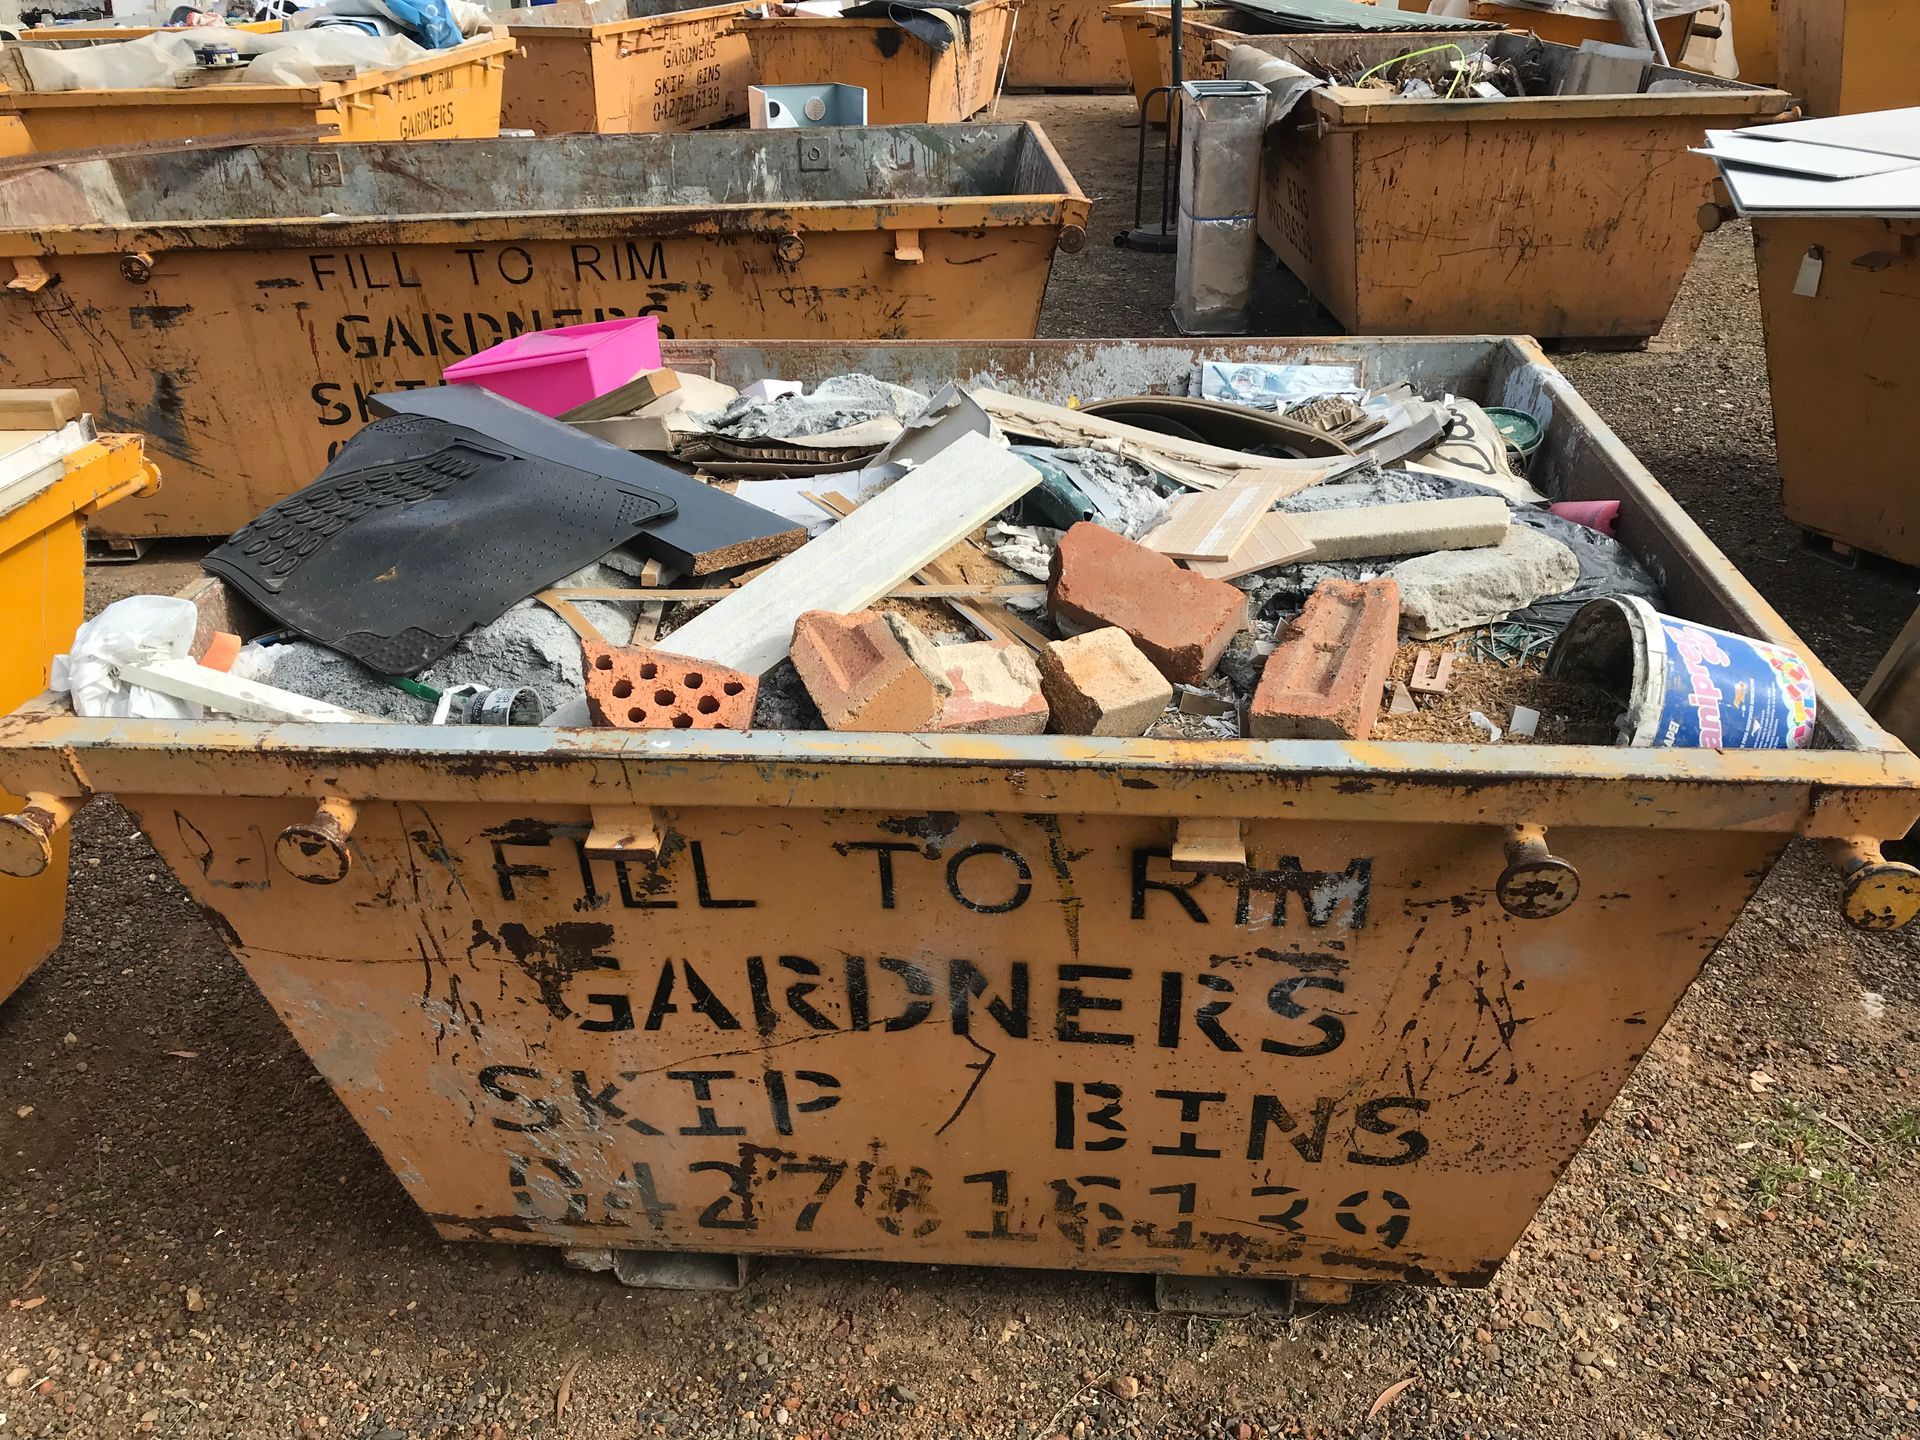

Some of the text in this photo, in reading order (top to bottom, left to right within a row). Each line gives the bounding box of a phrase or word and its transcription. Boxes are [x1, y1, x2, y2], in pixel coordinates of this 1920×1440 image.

[688, 21, 699, 37] TO
[664, 40, 716, 68] GARDNERS
[398, 79, 416, 103] FILL
[438, 69, 453, 92] RIM
[654, 64, 721, 97] SKIP BINS
[400, 102, 453, 140] GARDNERS
[309, 241, 669, 290] FILL TO RIM
[1663, 720, 1680, 748] APEI
[491, 840, 1373, 930] FILL TO RIM
[538, 955, 1346, 1057] GARDNERS
[479, 1065, 1430, 1166] SKIP BINS
